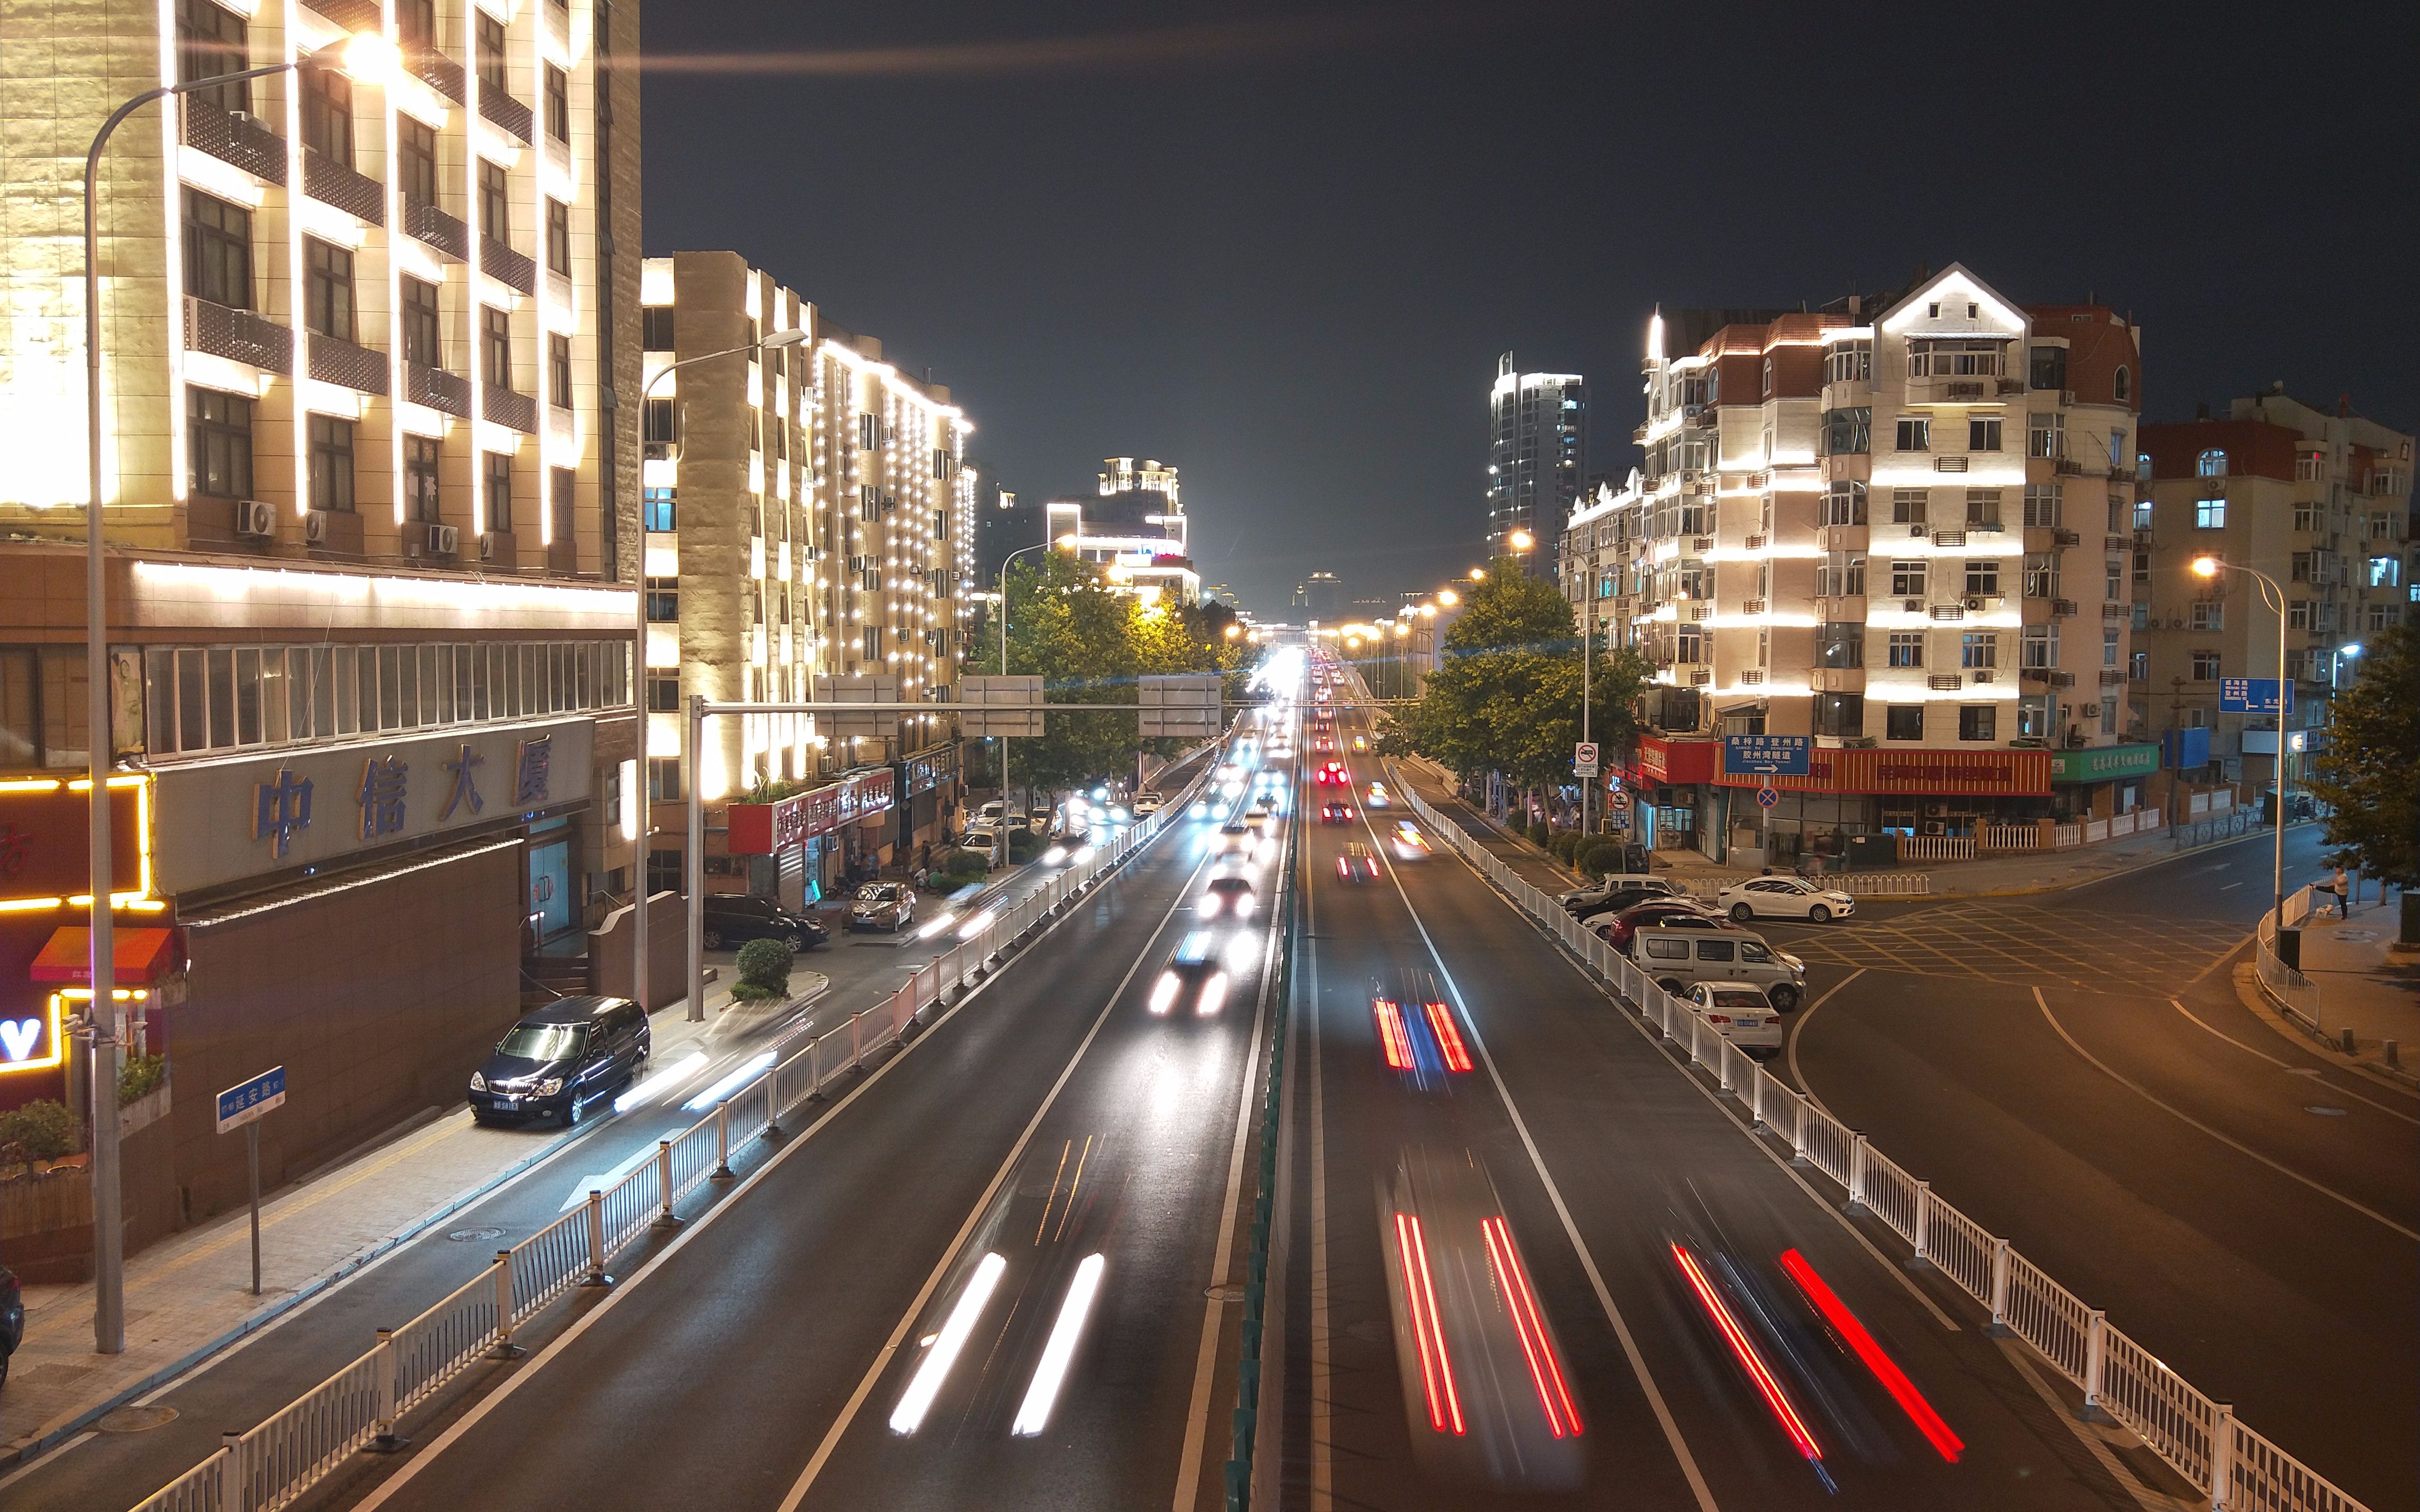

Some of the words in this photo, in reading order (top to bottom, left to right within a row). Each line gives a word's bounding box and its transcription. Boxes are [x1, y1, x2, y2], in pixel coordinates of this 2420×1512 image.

[1731, 737, 1765, 746] 桑梓路
[1770, 737, 1803, 747] 登州路
[1743, 751, 1791, 760] 胶州湾隧道
[252, 734, 551, 859] 中信大厦
[235, 1082, 270, 1112] 延安路
